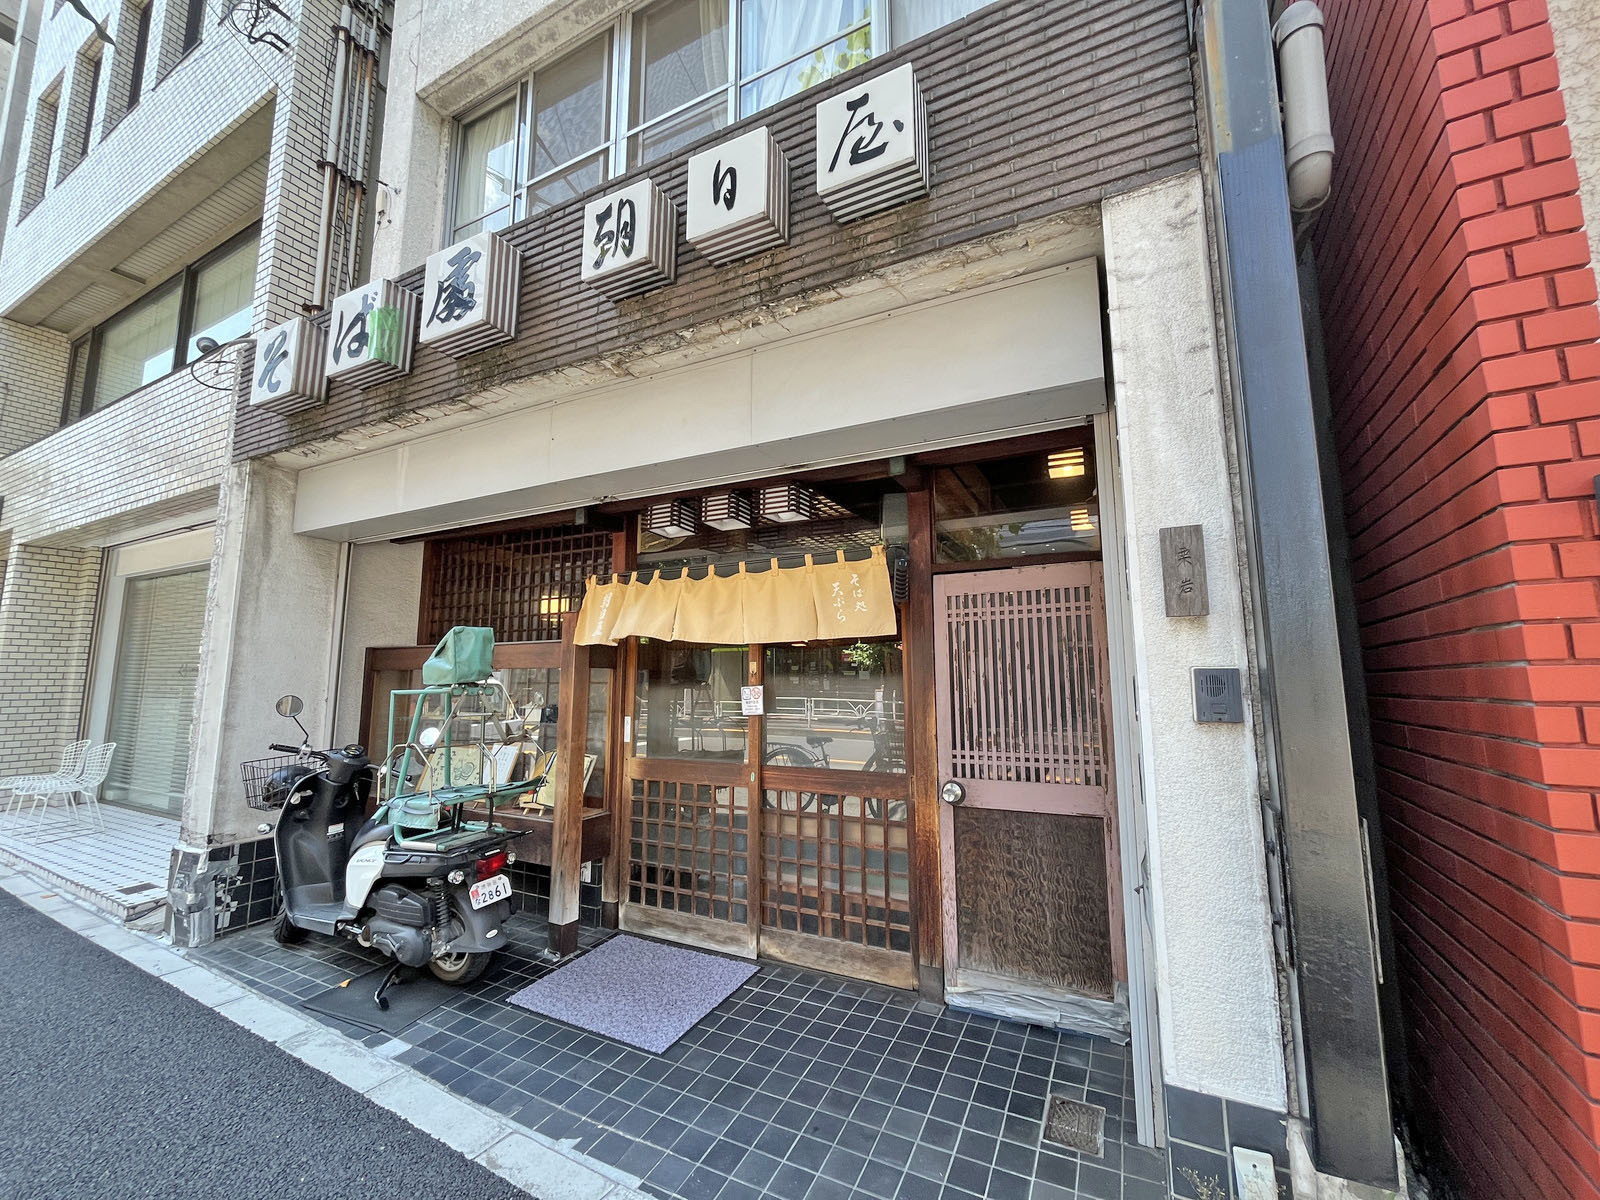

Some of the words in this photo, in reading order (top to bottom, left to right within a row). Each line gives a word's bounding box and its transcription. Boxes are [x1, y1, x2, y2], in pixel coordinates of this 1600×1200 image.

[592, 93, 905, 270] 朝日屋
[481, 882, 507, 904] 2861
